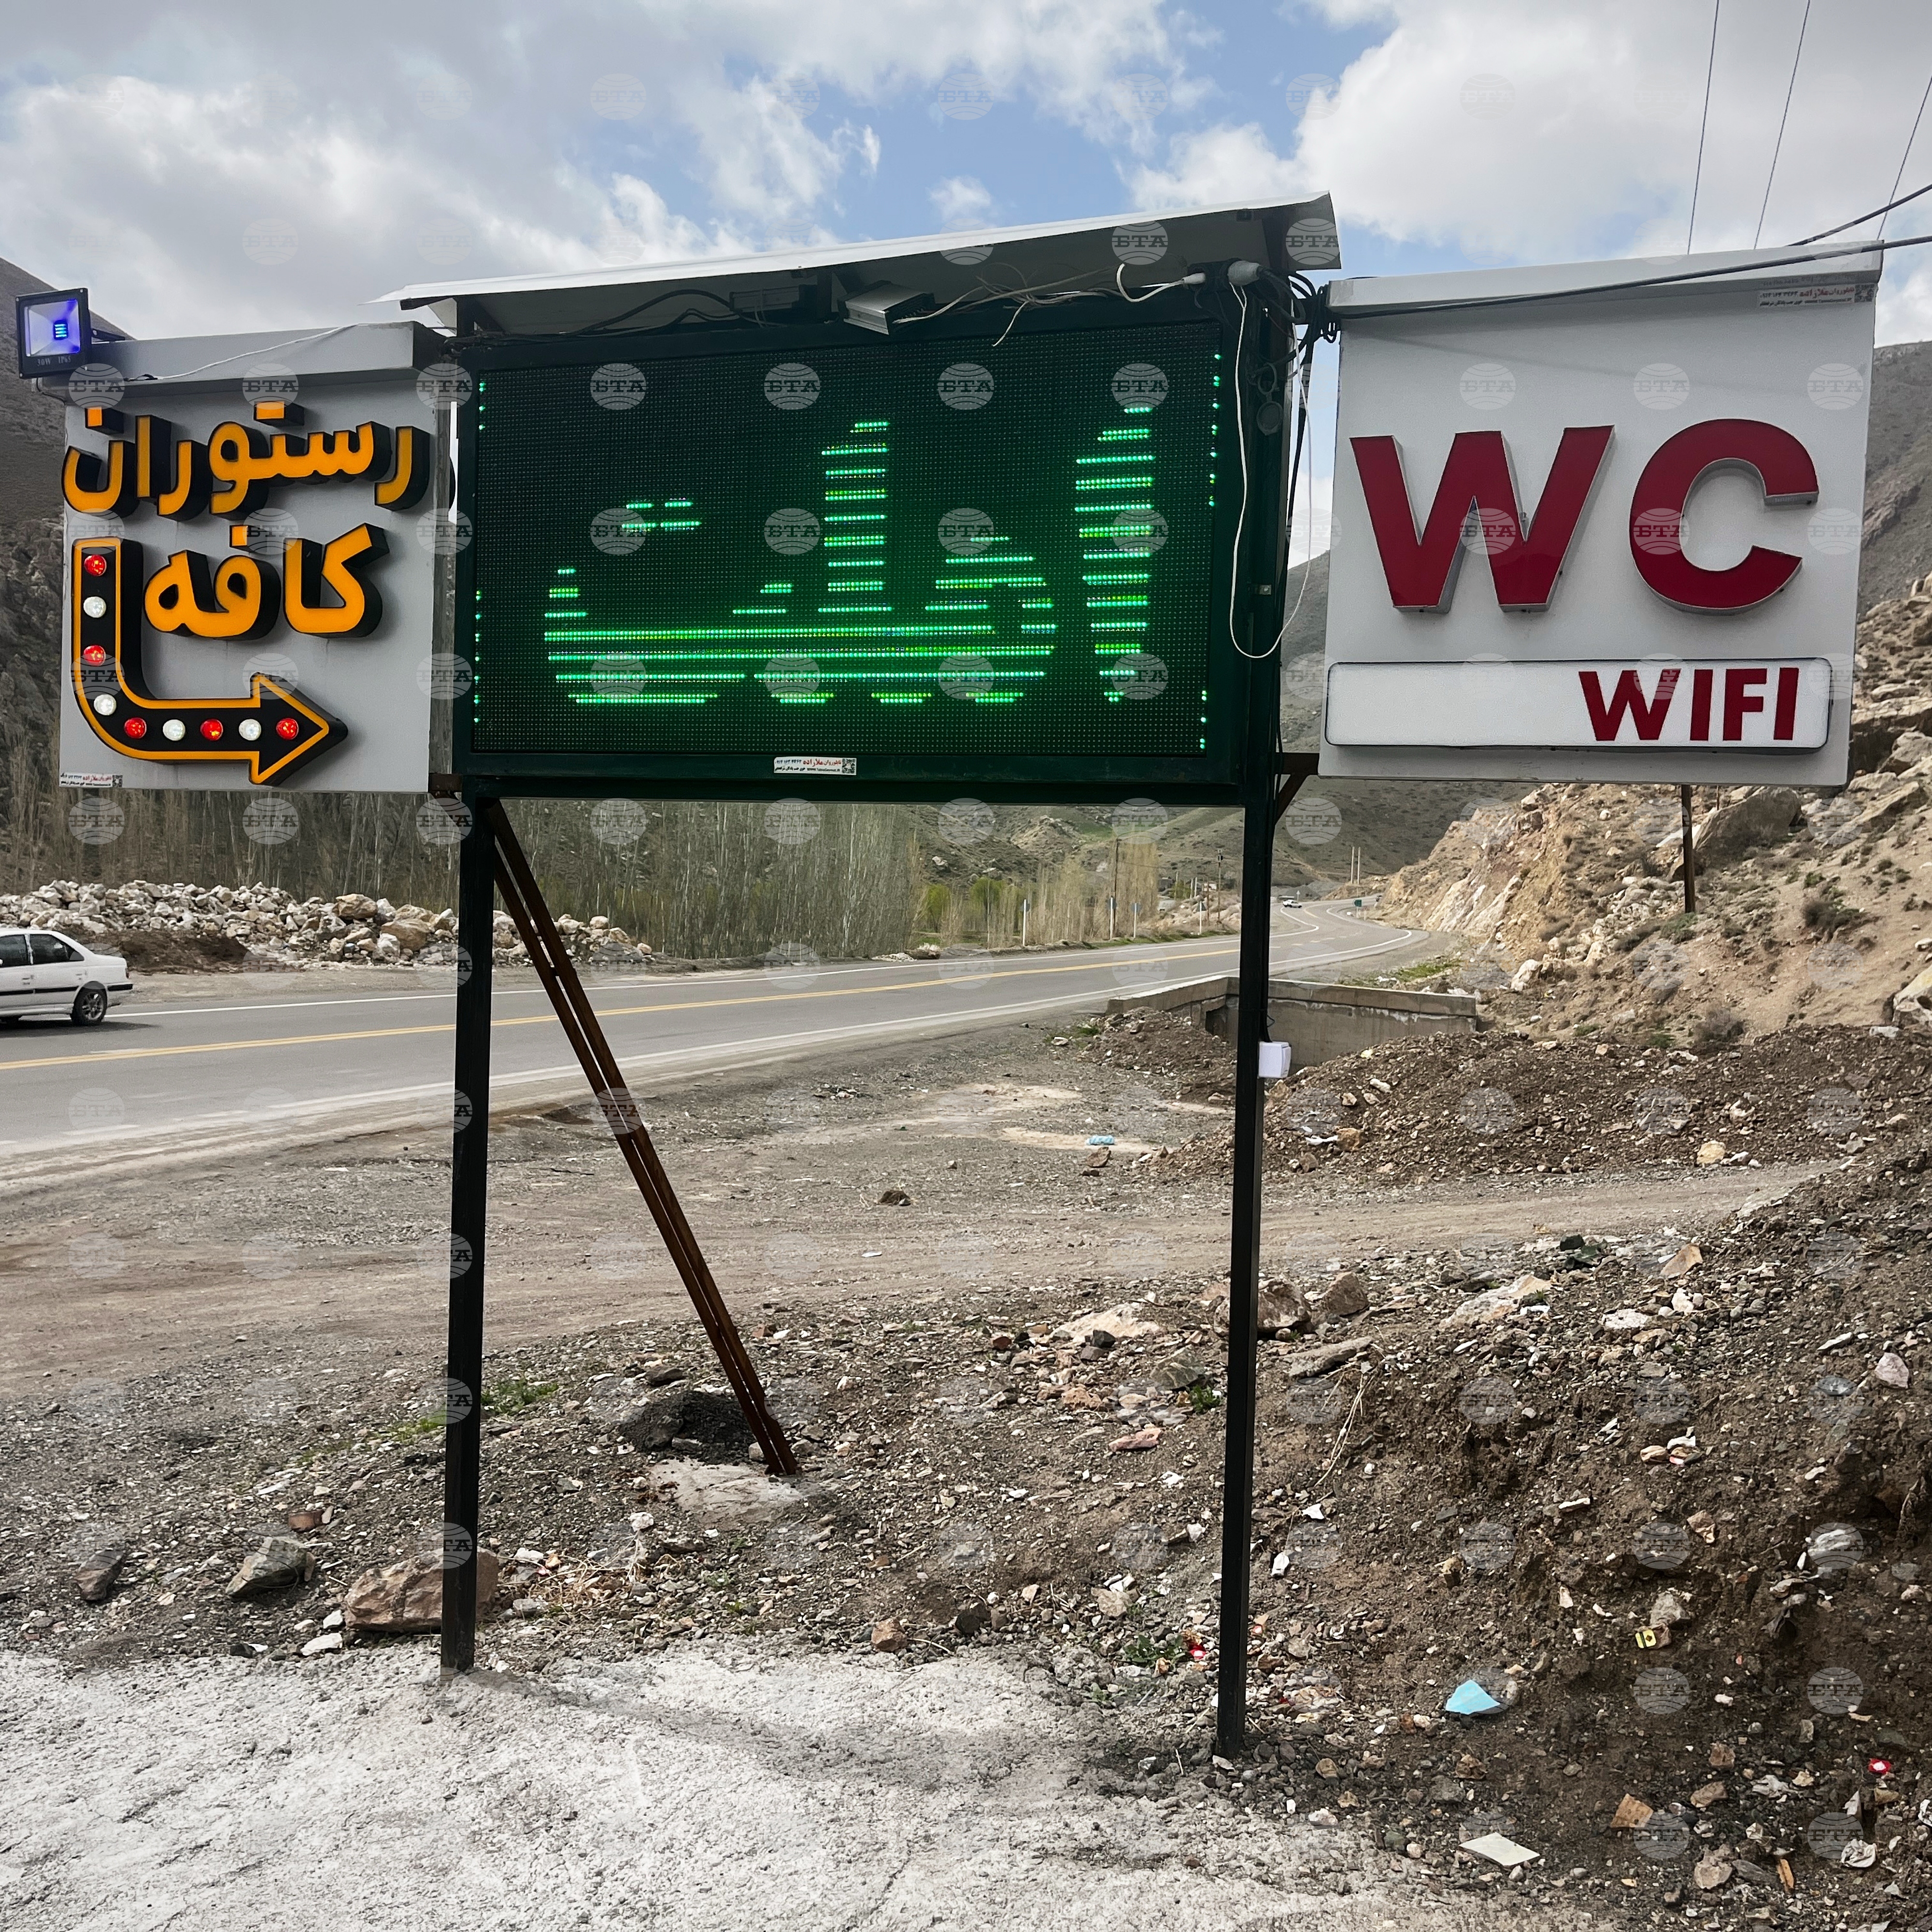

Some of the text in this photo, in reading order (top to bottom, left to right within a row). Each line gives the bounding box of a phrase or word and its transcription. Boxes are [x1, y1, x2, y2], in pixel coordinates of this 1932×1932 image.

[37, 358, 52, 367] 30W
[62, 400, 419, 520] رستوران
[1350, 418, 1818, 613] WC
[144, 525, 379, 638] کافه
[1578, 668, 1799, 742] WIFI
